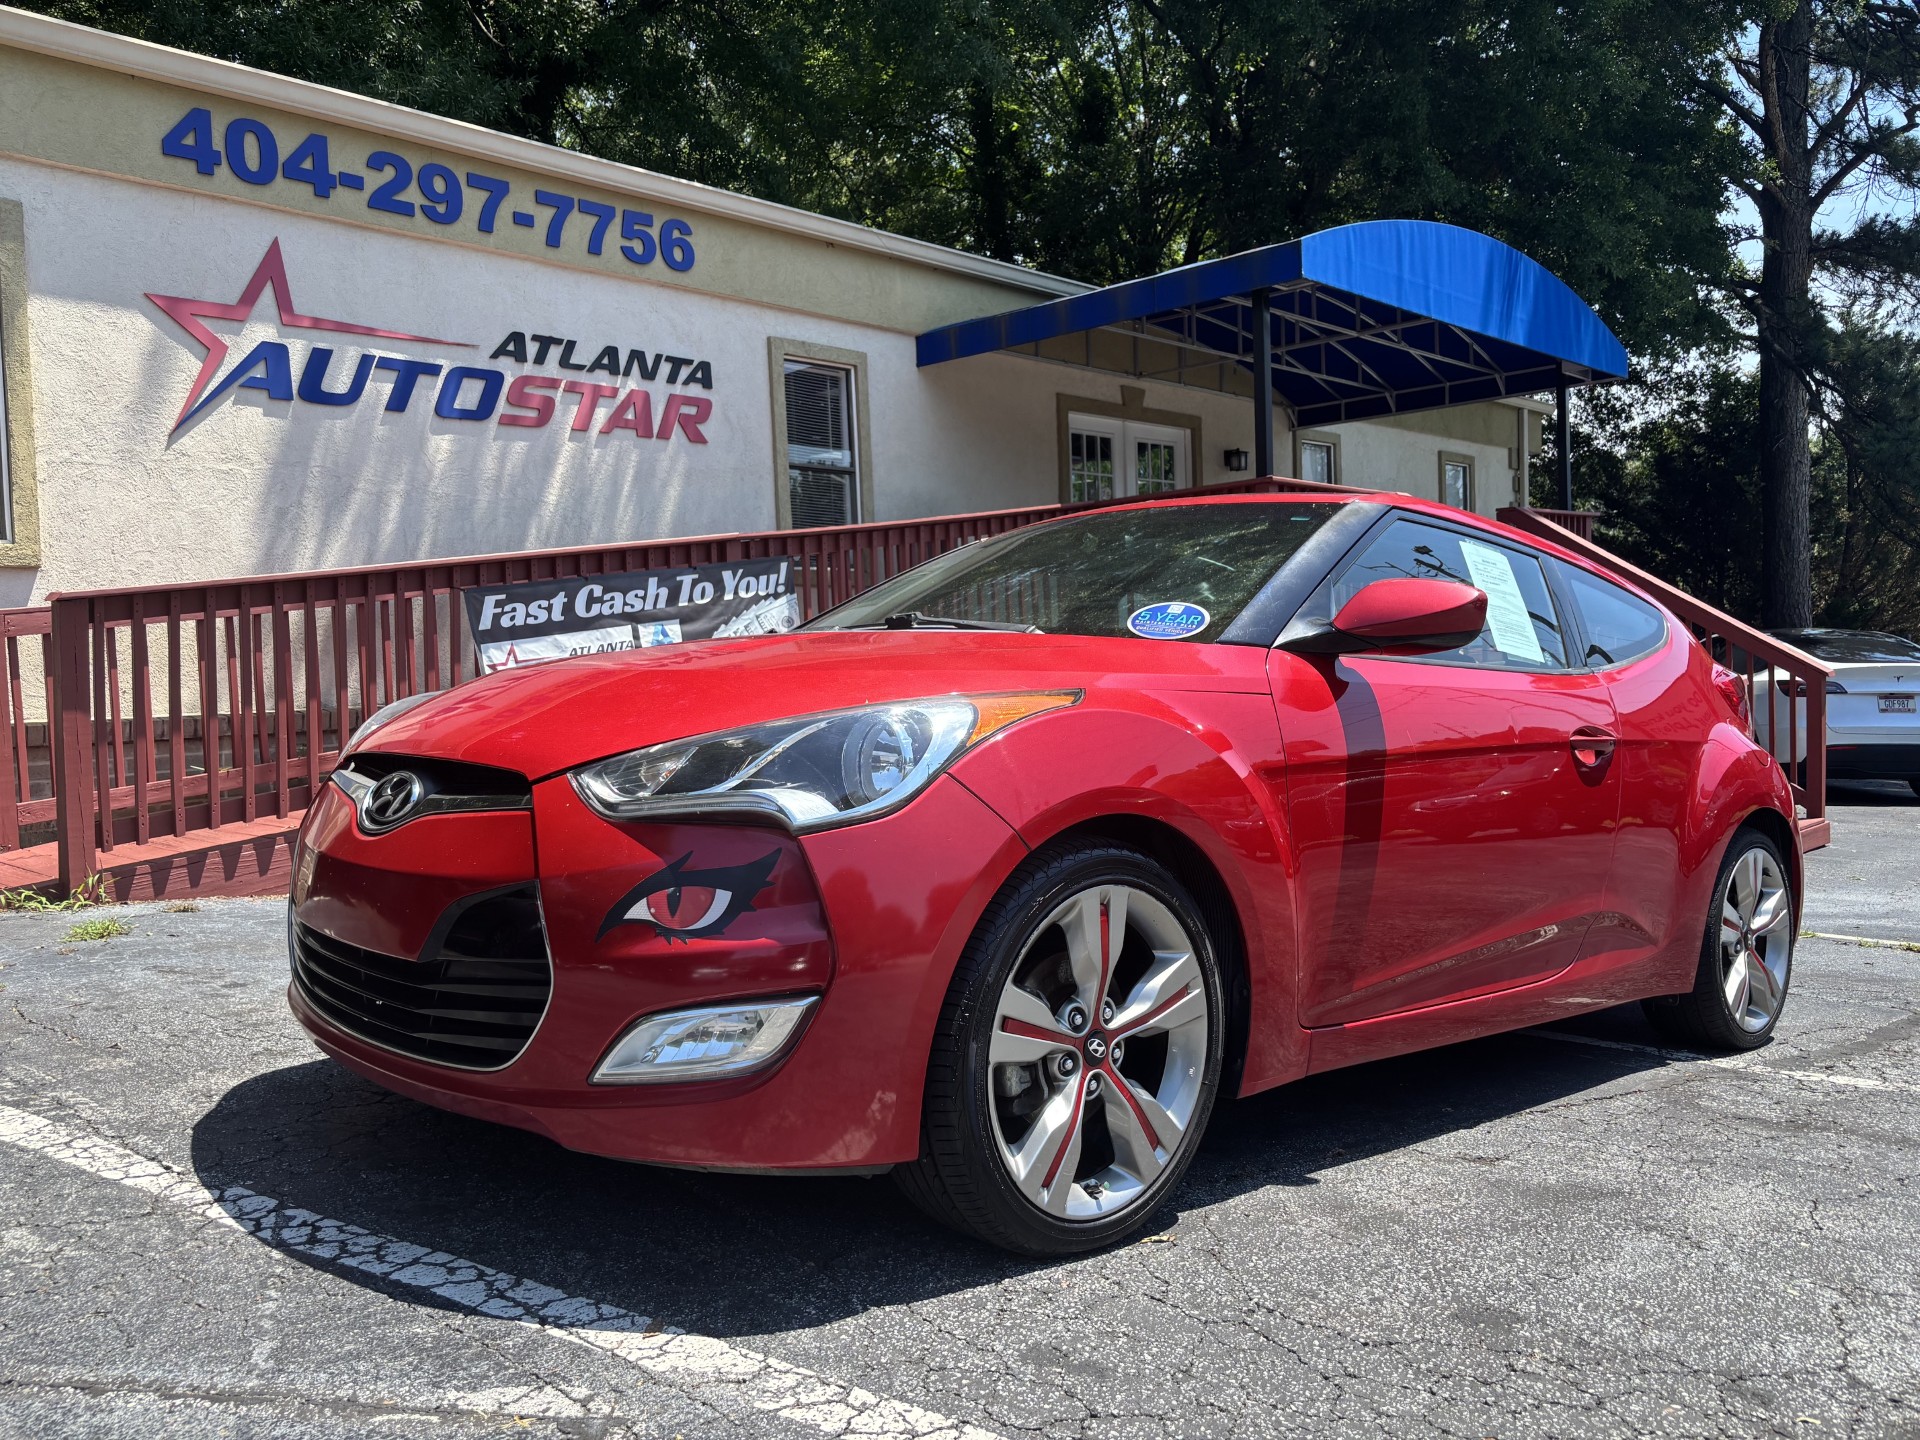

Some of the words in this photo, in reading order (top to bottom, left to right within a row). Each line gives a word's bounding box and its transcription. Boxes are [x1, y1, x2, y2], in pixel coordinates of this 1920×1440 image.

[161, 107, 696, 272] 404-297-7756
[488, 330, 714, 389] ATLANTA
[478, 591, 568, 630] Fast
[574, 577, 669, 619] Cash
[676, 573, 714, 607] To
[721, 561, 789, 601] You!
[1138, 611, 1152, 621] 5
[1156, 612, 1202, 625] YEAR
[569, 639, 634, 657] ATLANTA
